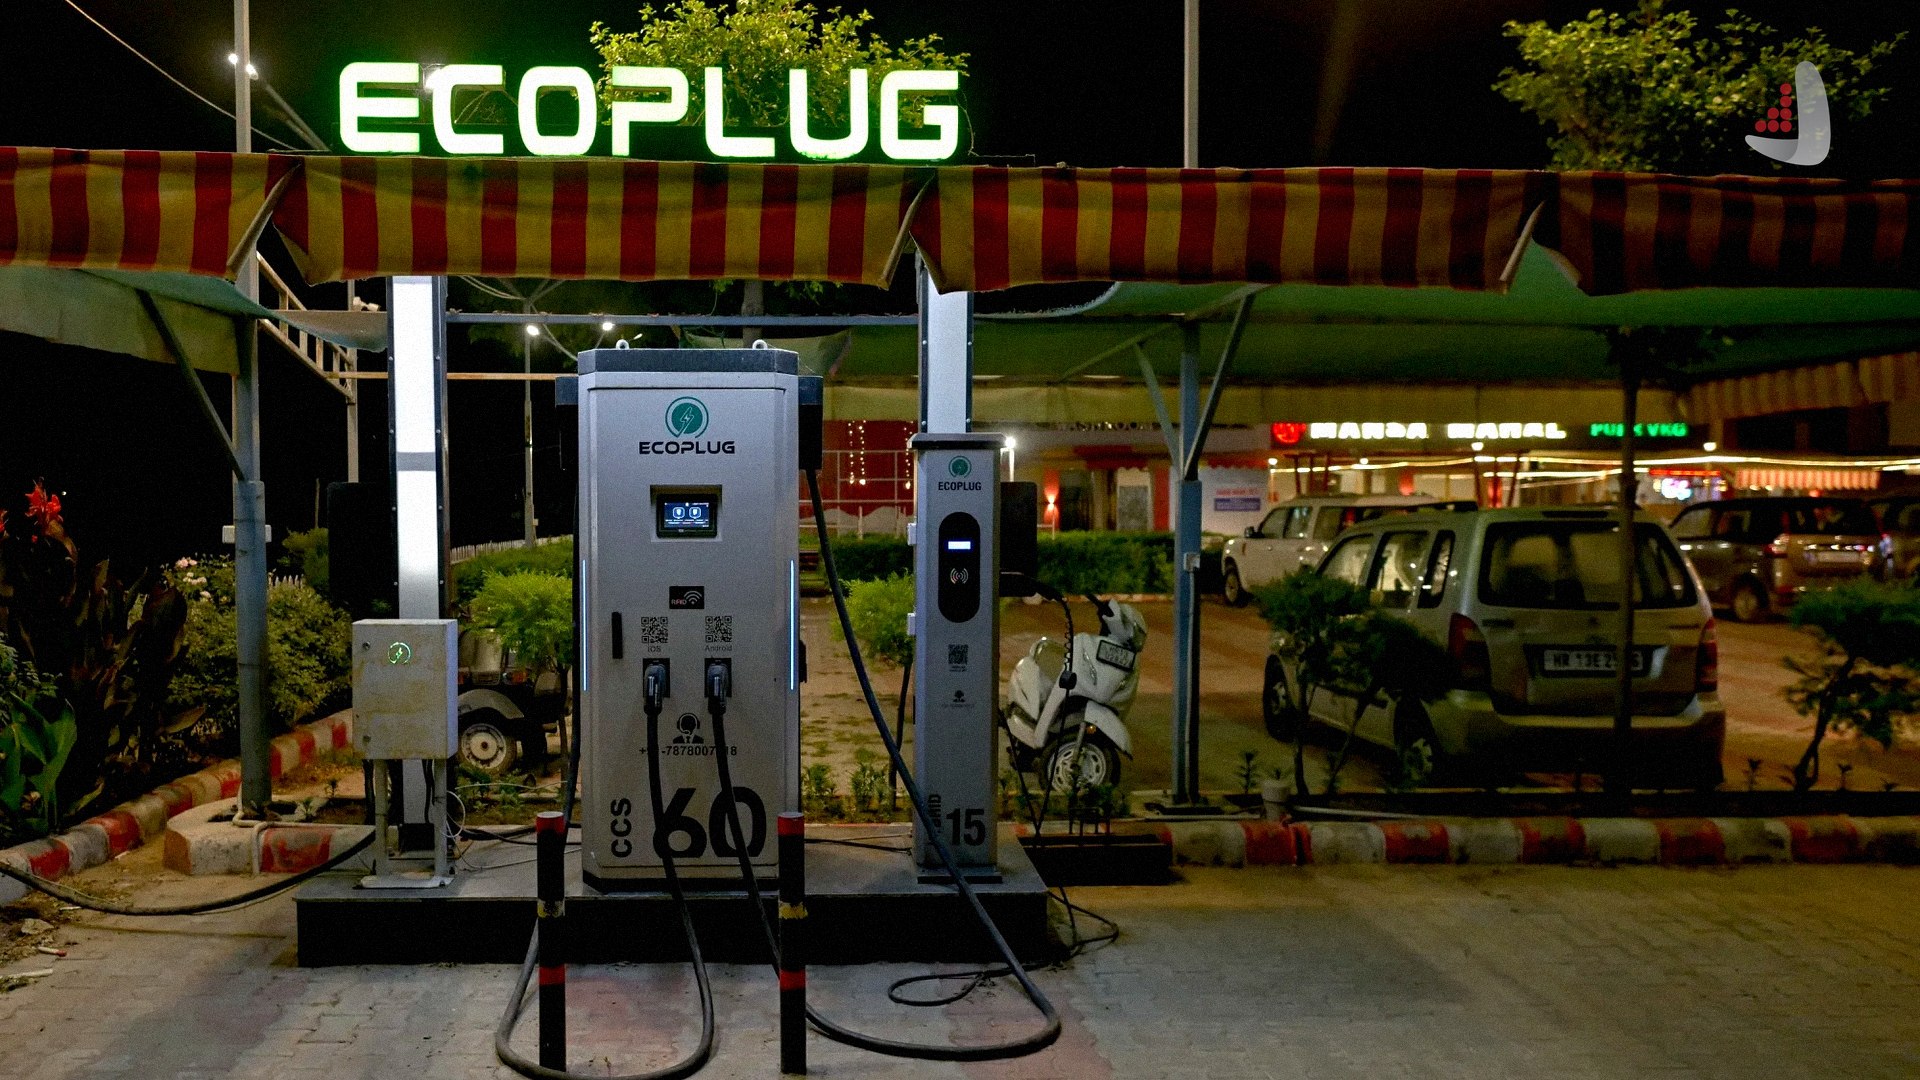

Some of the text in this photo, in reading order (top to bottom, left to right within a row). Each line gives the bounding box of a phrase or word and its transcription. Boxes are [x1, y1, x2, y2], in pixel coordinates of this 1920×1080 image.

[339, 61, 960, 161] ECOPLUG
[639, 441, 735, 455] ECOPLUG
[938, 481, 982, 491] ECOPLUG
[704, 644, 733, 653] Android
[610, 797, 632, 858] CCS
[653, 787, 767, 858] 60
[946, 808, 986, 847] 15
